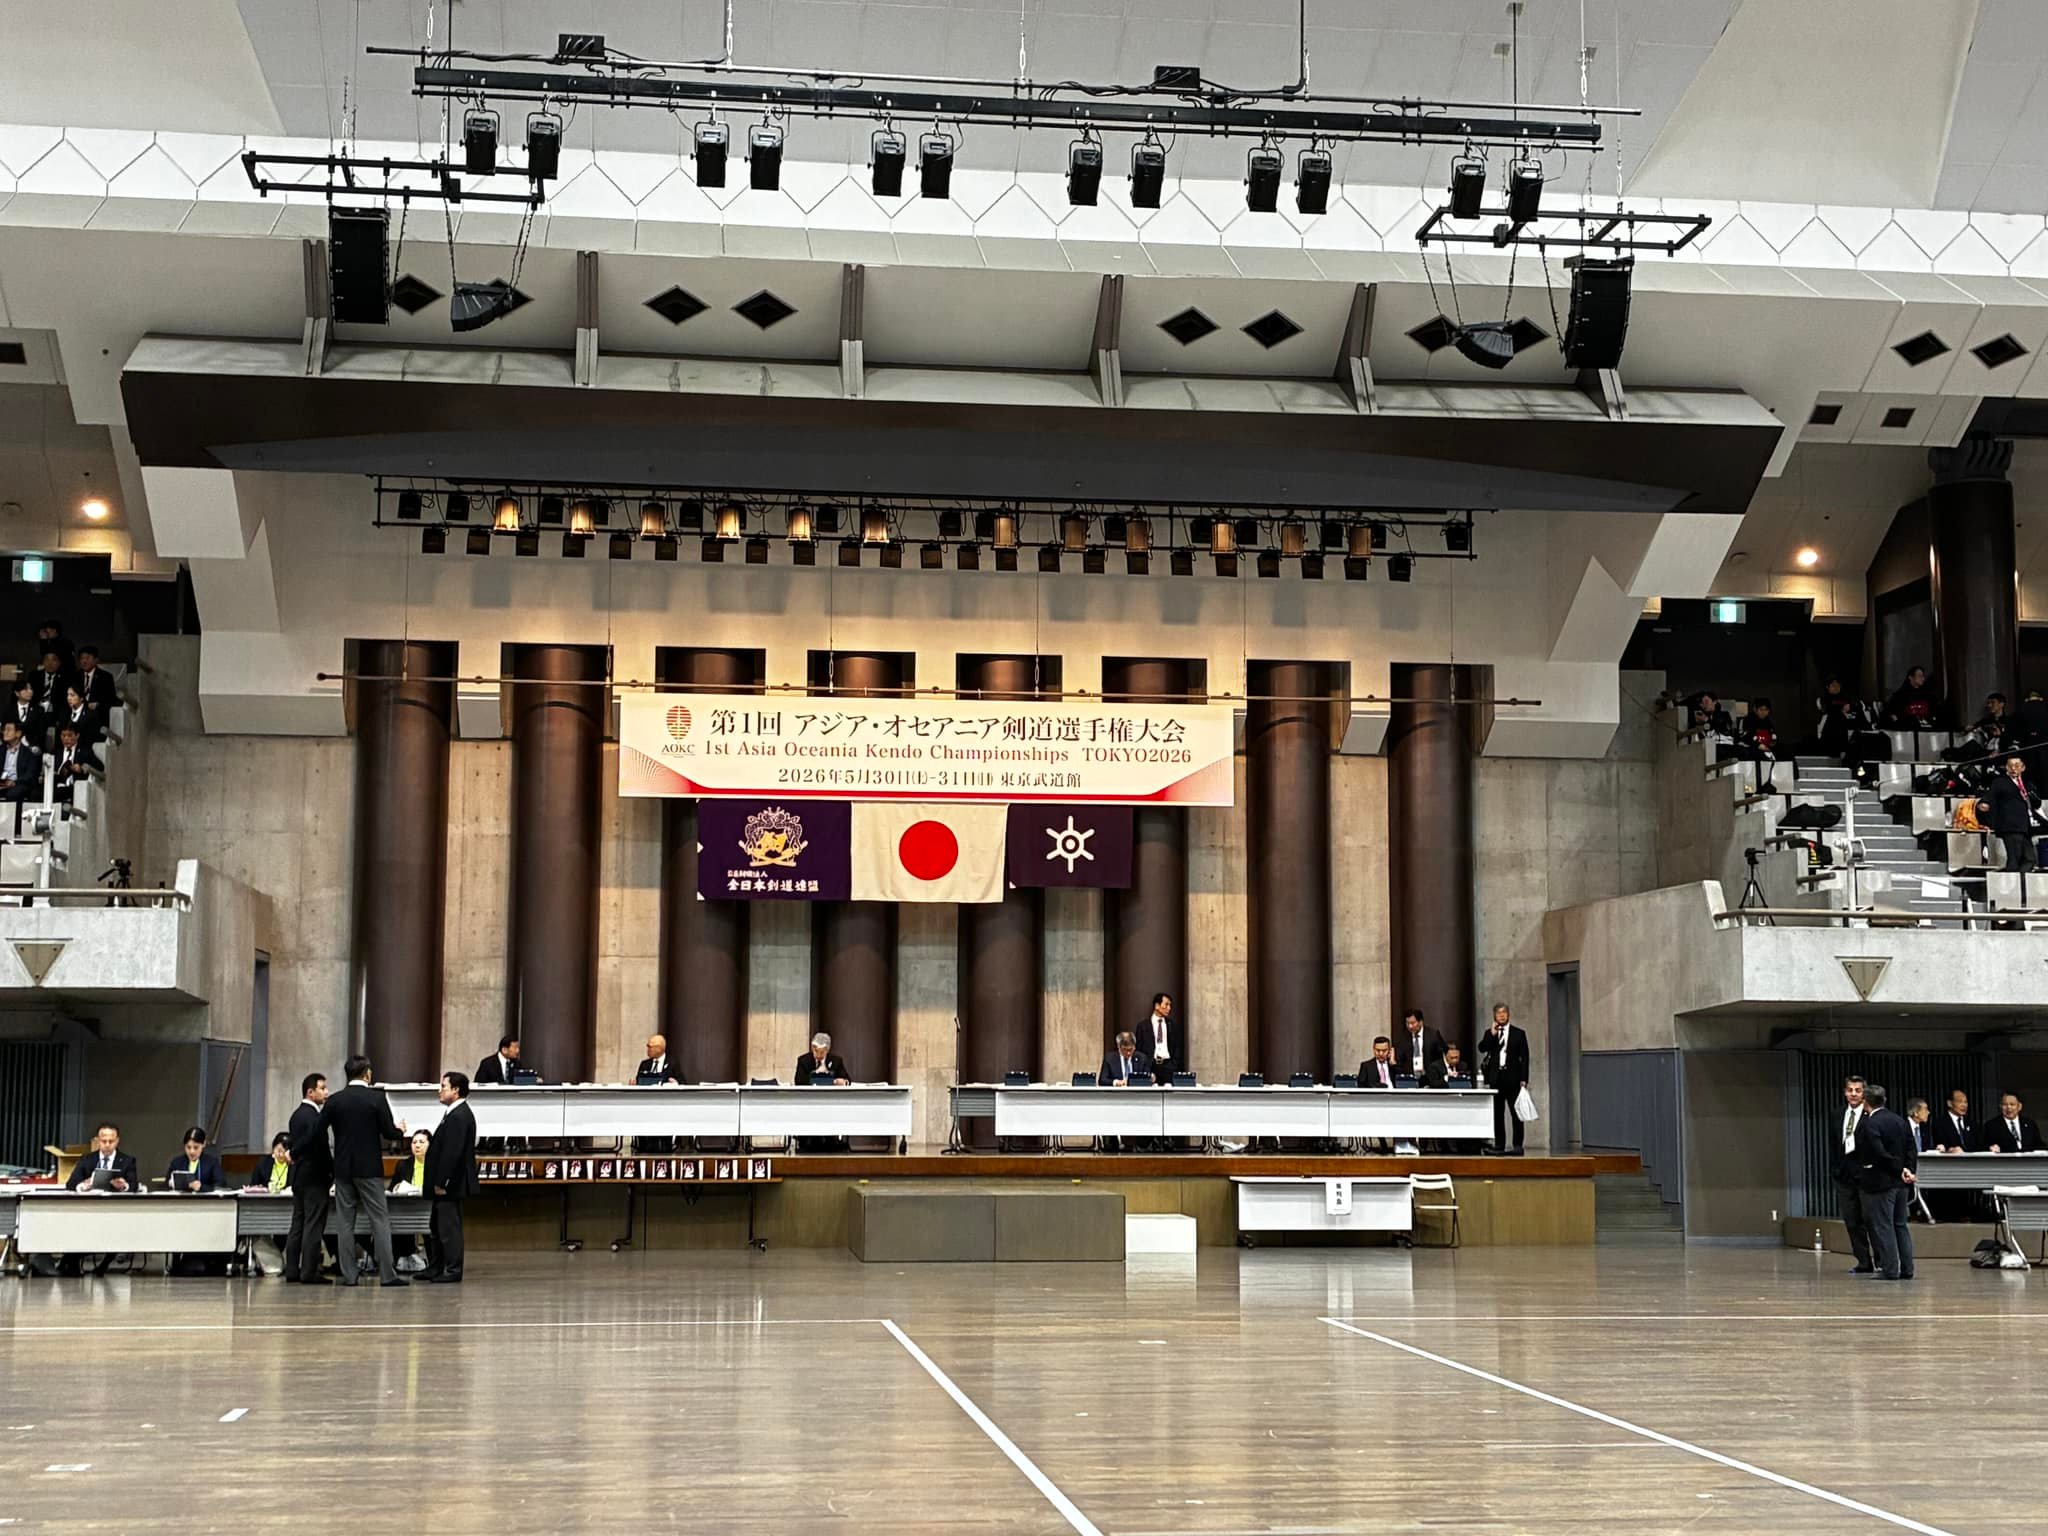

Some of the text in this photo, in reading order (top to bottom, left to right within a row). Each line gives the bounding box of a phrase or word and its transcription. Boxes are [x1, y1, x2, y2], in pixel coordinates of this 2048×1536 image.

[711, 709, 1187, 743] 第1回 アジア・オセアニア剣道選手権大会
[661, 743, 695, 754] AOKC
[706, 740, 1191, 765] 1st Asia Oceania Kendo Championships TOKYO2026
[1001, 771, 1081, 789] 東京武道館
